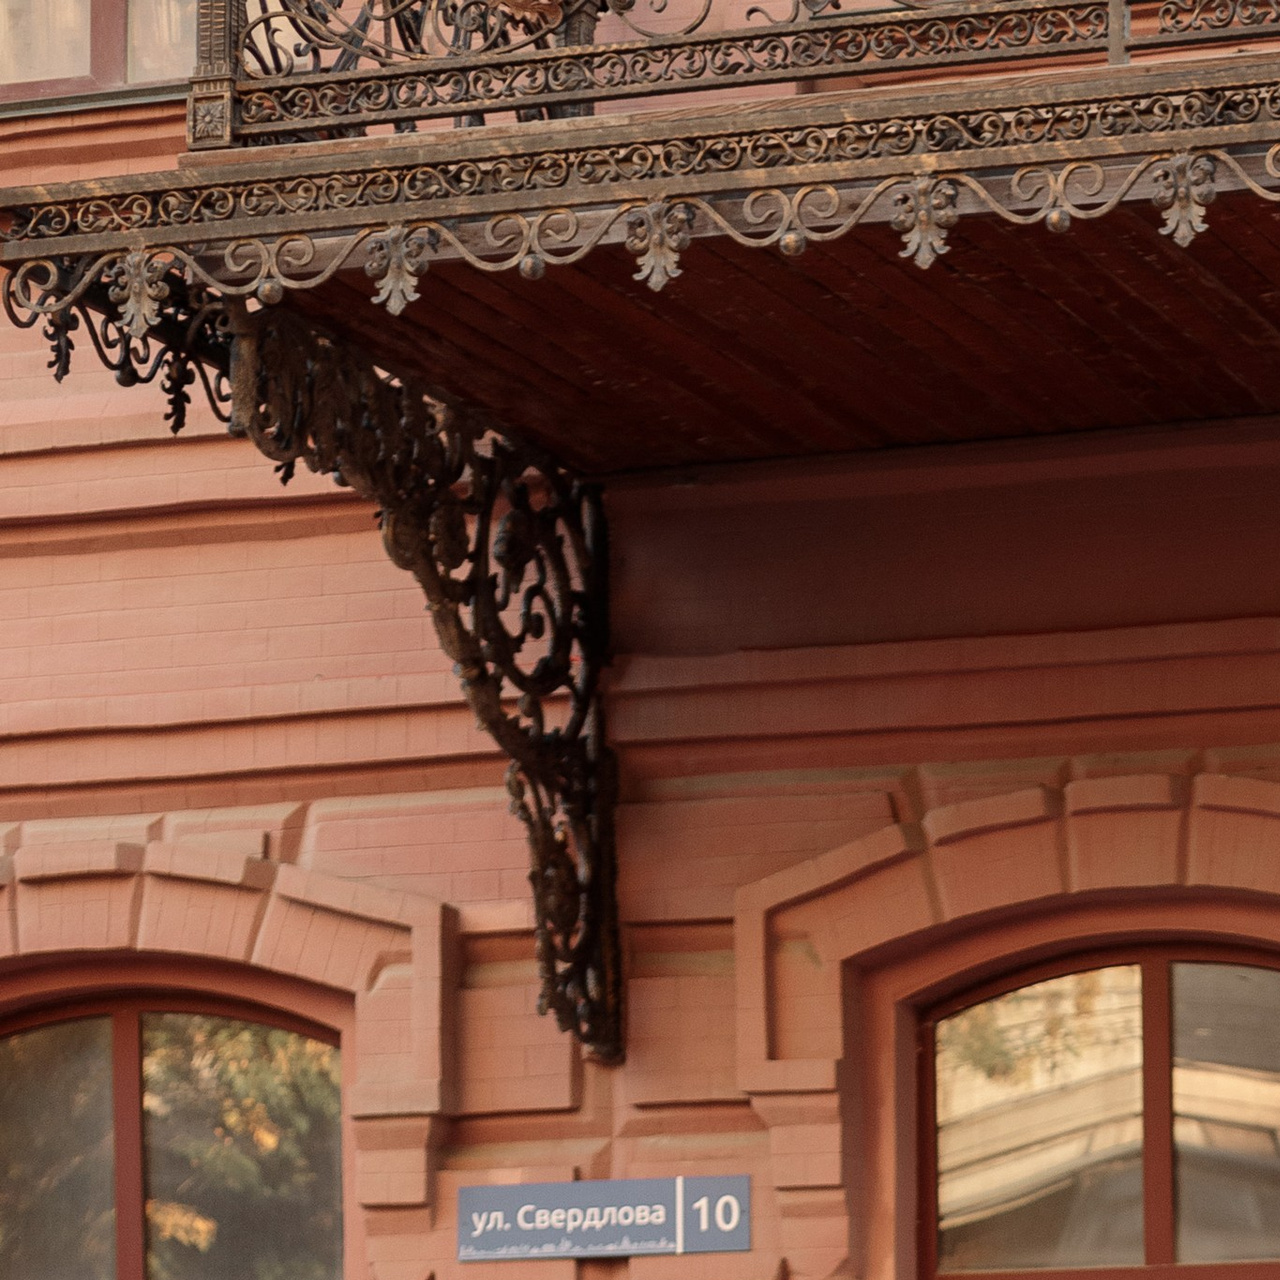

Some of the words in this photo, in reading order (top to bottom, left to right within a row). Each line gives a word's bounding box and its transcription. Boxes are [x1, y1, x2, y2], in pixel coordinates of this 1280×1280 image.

[471, 1210, 511, 1238] ул.
[516, 1203, 667, 1233] Свердлова
[692, 1194, 741, 1233] 10
